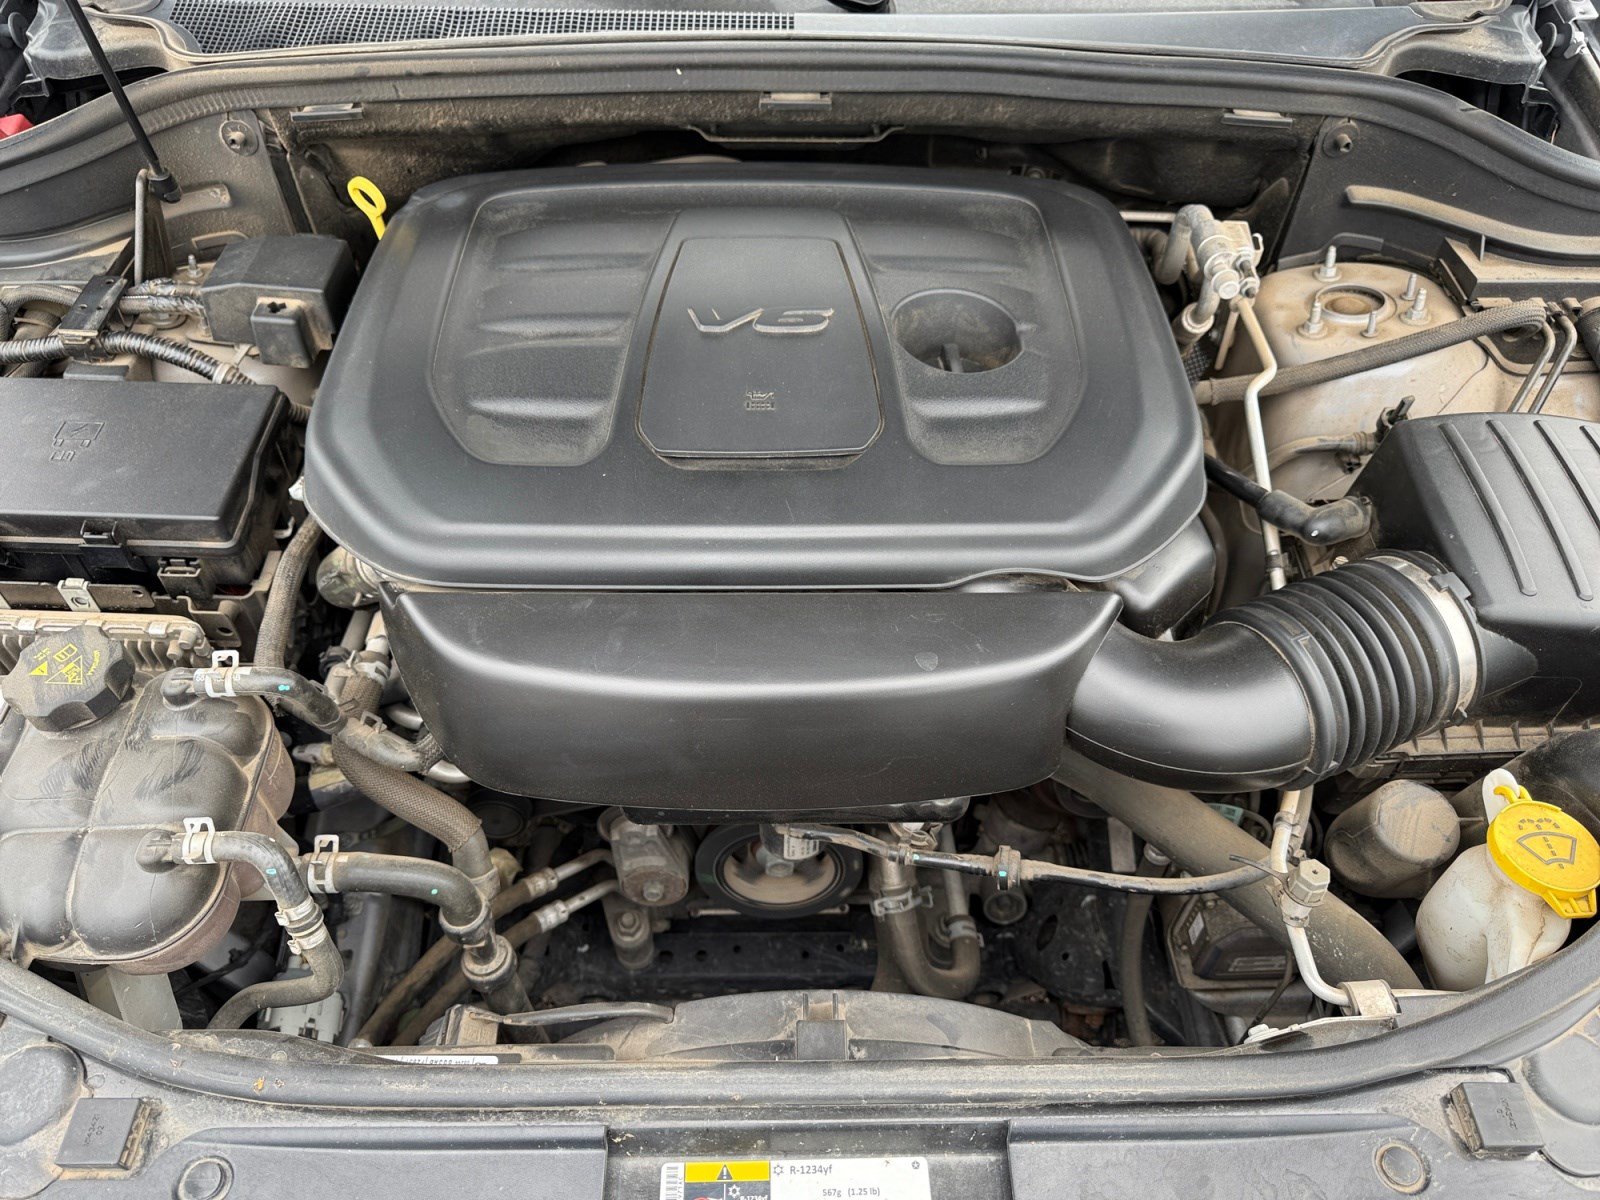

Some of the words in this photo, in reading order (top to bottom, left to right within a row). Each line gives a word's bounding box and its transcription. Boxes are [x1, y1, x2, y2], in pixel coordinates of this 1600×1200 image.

[687, 306, 835, 335] V6
[789, 1164, 833, 1176] R-1234yf
[822, 1188, 842, 1198] 567g
[847, 1187, 868, 1198] (1.25
[869, 1187, 881, 1197] lb)
